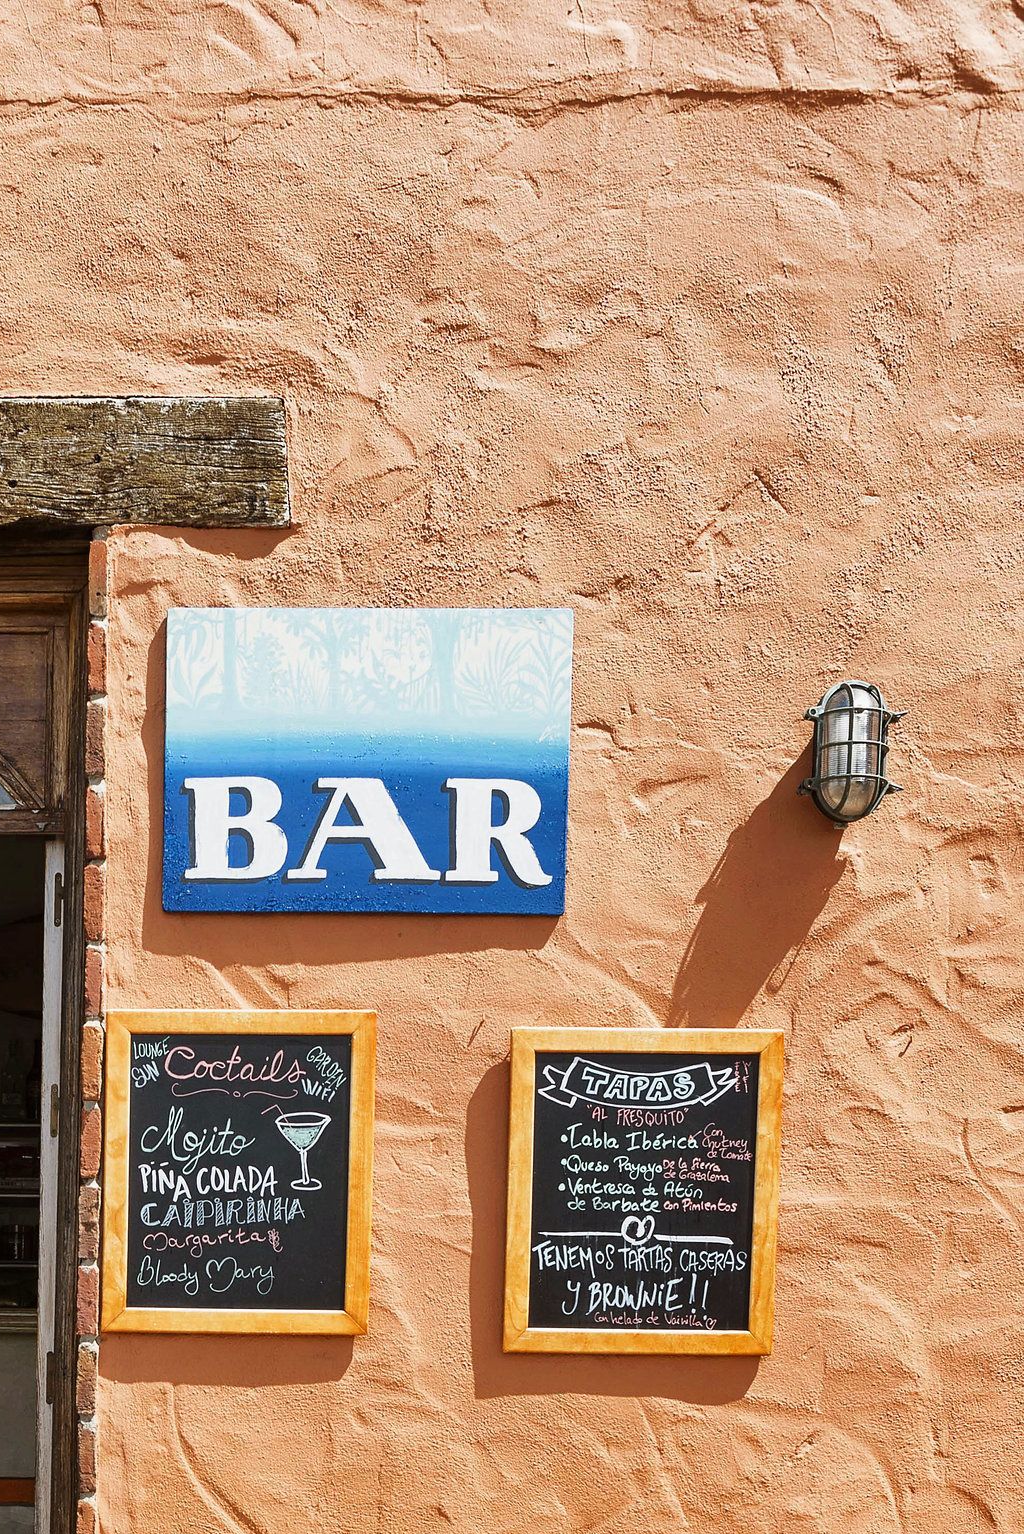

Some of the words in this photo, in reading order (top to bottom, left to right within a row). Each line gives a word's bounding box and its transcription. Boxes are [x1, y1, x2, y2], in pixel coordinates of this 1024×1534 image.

[182, 776, 553, 888] BAR
[133, 1036, 170, 1060] LOUNGE
[131, 1061, 160, 1088] SUN
[164, 1045, 307, 1083] Coctails
[306, 1045, 347, 1089] GARDEN
[581, 1066, 696, 1101] TAPAS
[140, 1105, 256, 1175] Mojito
[567, 1123, 619, 1149] Tabla
[625, 1130, 698, 1151] Ibérica
[566, 1154, 609, 1174] Queso
[613, 1155, 663, 1181] Payoyo
[663, 1169, 676, 1179] de
[678, 1157, 687, 1170] la
[196, 1165, 278, 1197] COLADA
[567, 1177, 636, 1196] Ventresca
[642, 1182, 658, 1196] de
[664, 1181, 703, 1199] Atún
[567, 1196, 586, 1211] de
[592, 1196, 661, 1212] Barbate
[142, 1227, 267, 1258] Margarita
[532, 1240, 614, 1278] TENEMOS
[618, 1246, 673, 1274] TARTAS
[679, 1249, 747, 1276] CASERAS
[137, 1255, 199, 1296] Bloody
[205, 1256, 275, 1295] Mary
[610, 1310, 642, 1325] helado
[646, 1310, 660, 1325] de
